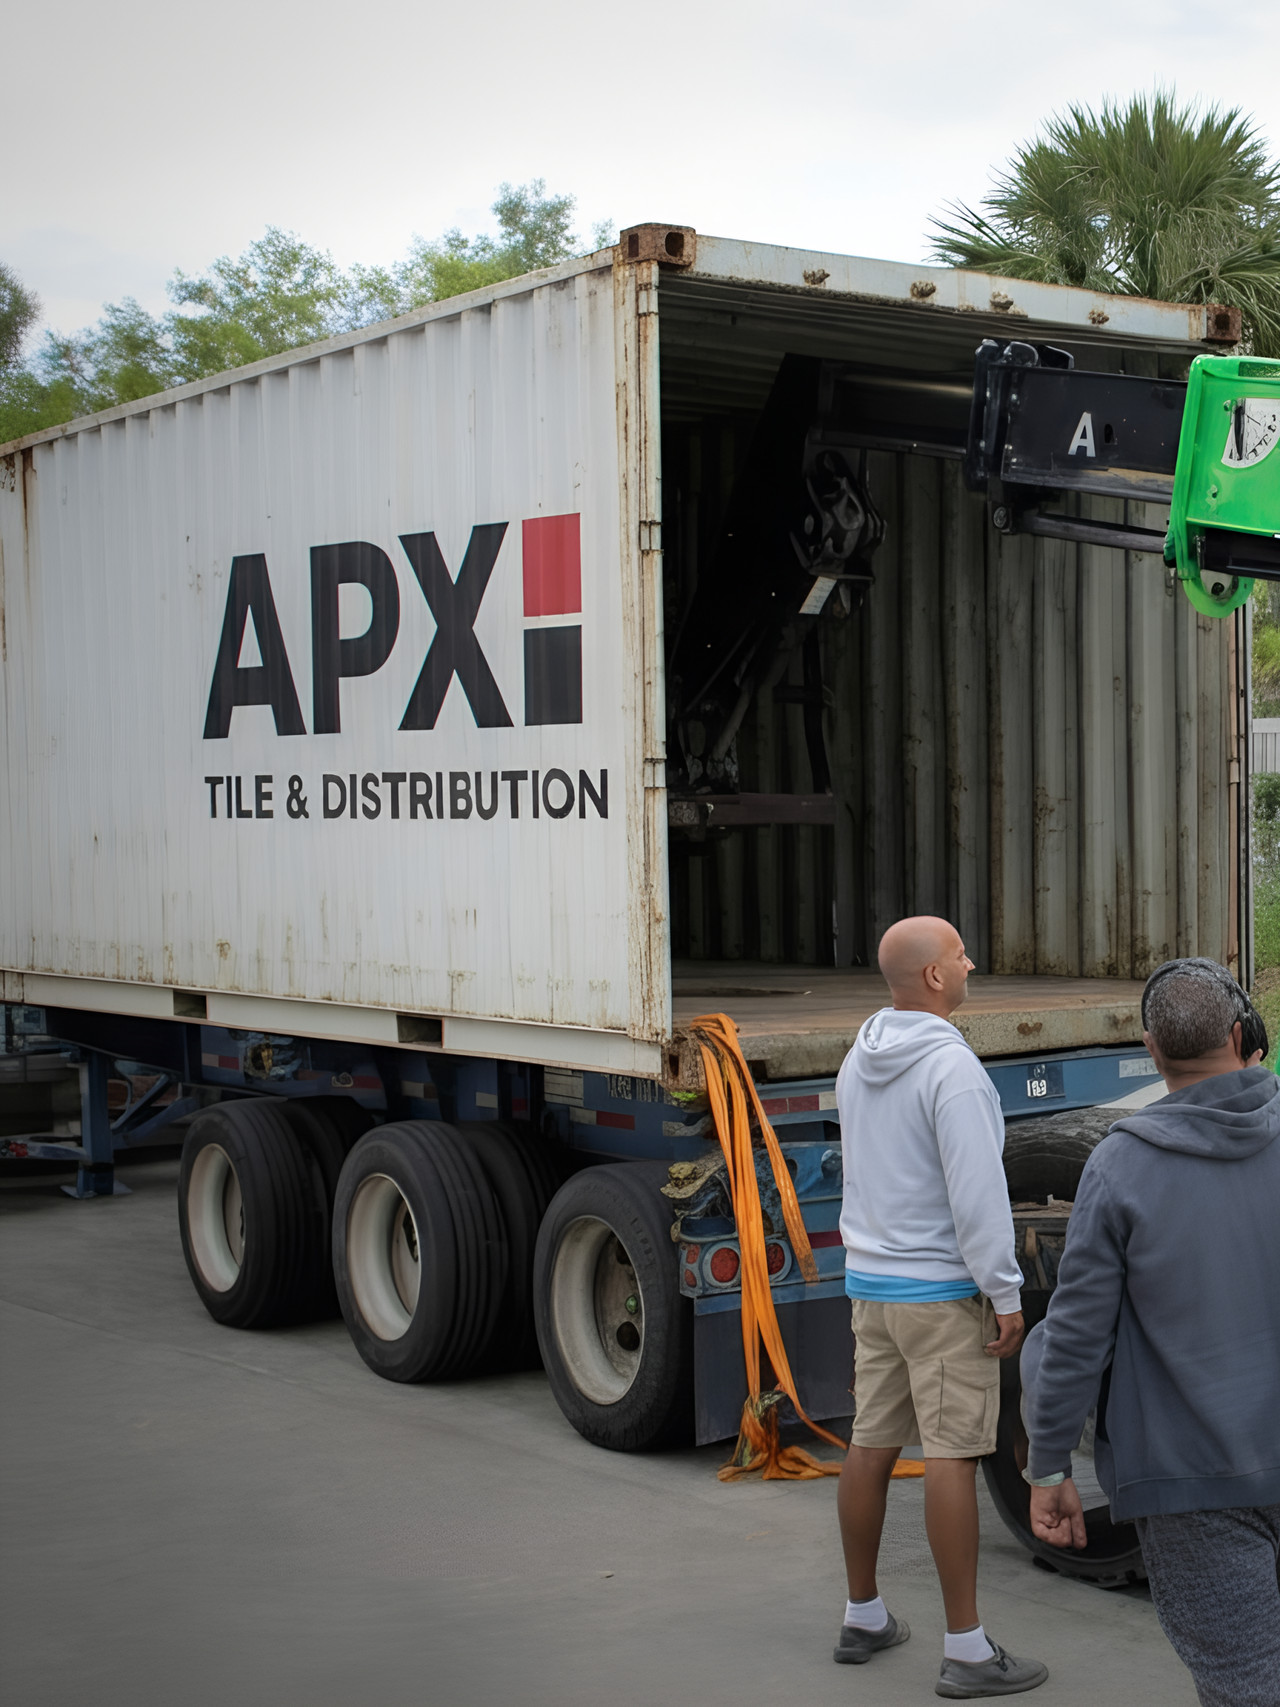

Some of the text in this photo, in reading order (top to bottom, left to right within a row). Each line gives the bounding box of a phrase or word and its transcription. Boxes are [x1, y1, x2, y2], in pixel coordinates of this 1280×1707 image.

[1068, 411, 1096, 457] A
[202, 521, 515, 740] APX
[204, 767, 609, 821] TILE & DISTRIBUTION
